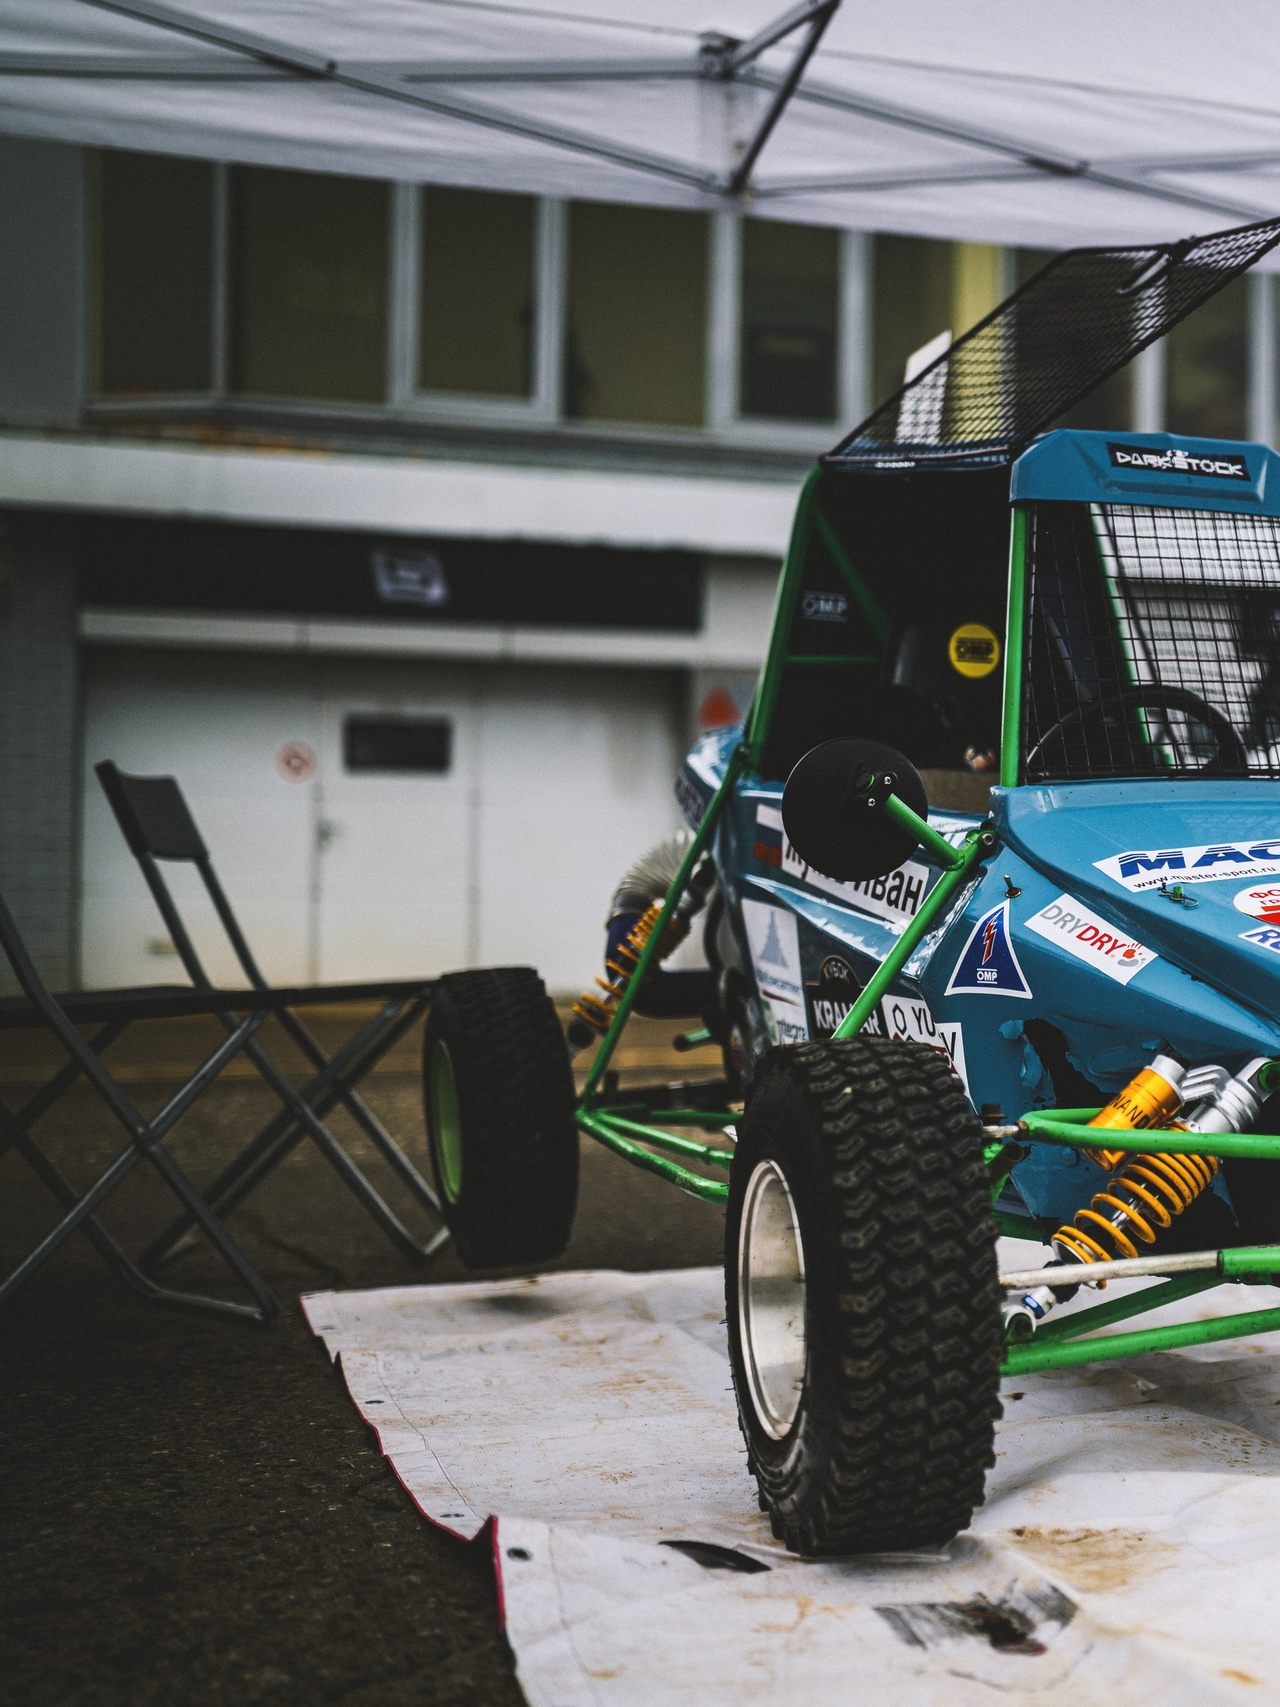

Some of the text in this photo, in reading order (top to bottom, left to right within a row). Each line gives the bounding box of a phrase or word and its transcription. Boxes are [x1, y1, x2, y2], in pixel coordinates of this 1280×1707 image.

[1116, 451, 1244, 476] DARKSTOCK
[1133, 866, 1277, 888] www.master-sport.ru
[976, 970, 998, 982] OMP
